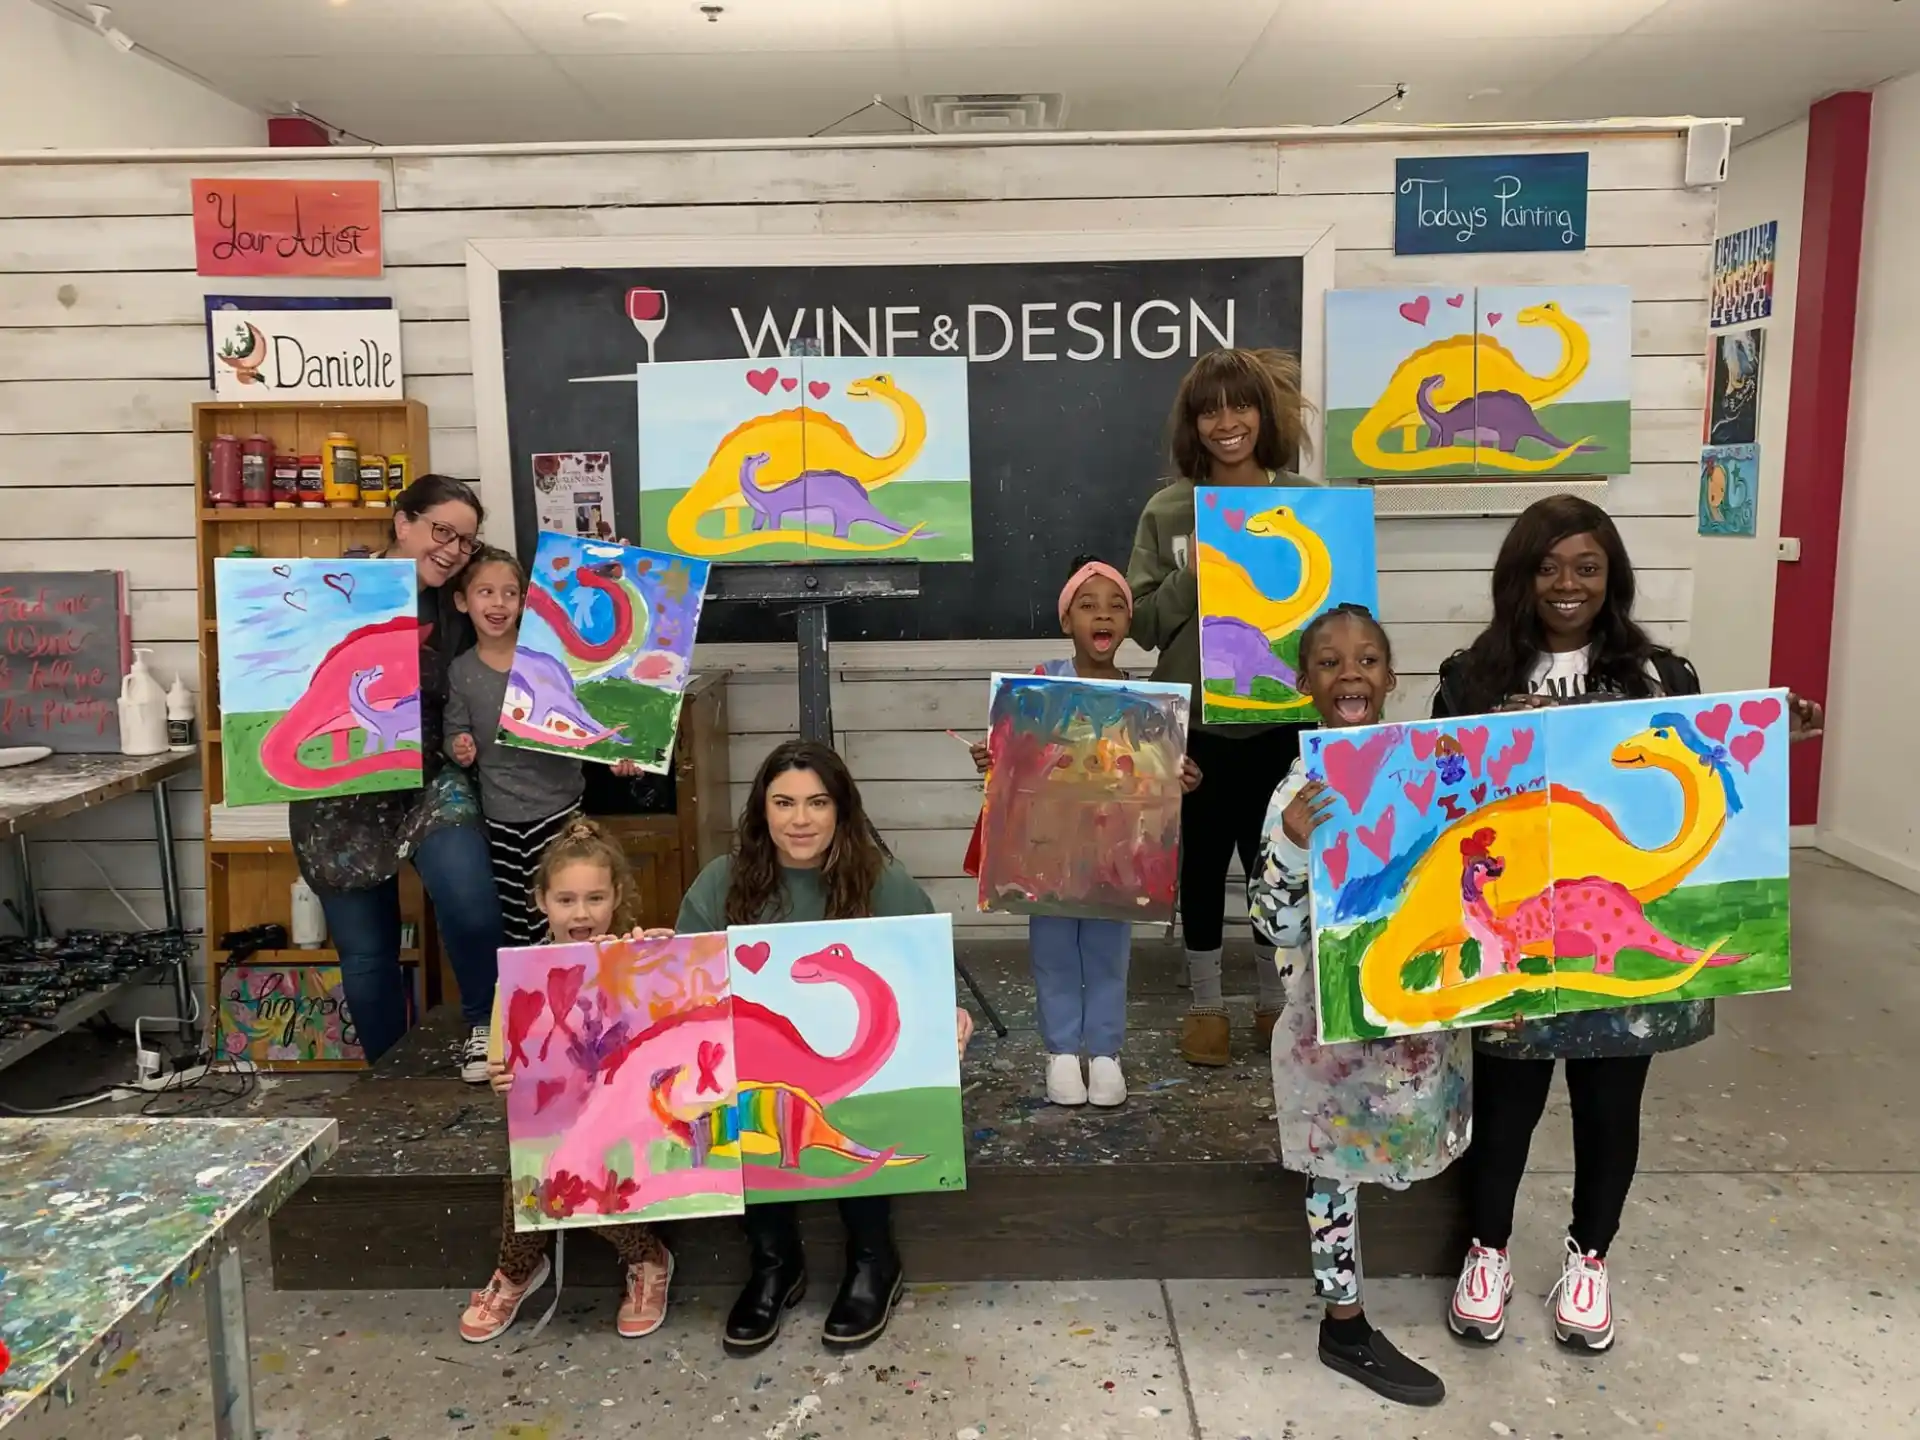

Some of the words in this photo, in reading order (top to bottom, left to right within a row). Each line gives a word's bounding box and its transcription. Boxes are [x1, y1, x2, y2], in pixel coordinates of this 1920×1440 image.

[206, 192, 272, 260] Your
[276, 194, 370, 258] Artist
[1400, 177, 1488, 242] Today's
[1493, 175, 1579, 244] Painting
[272, 335, 395, 388] Danielle
[730, 305, 920, 357] WINE
[968, 298, 1235, 362] DESIGN
